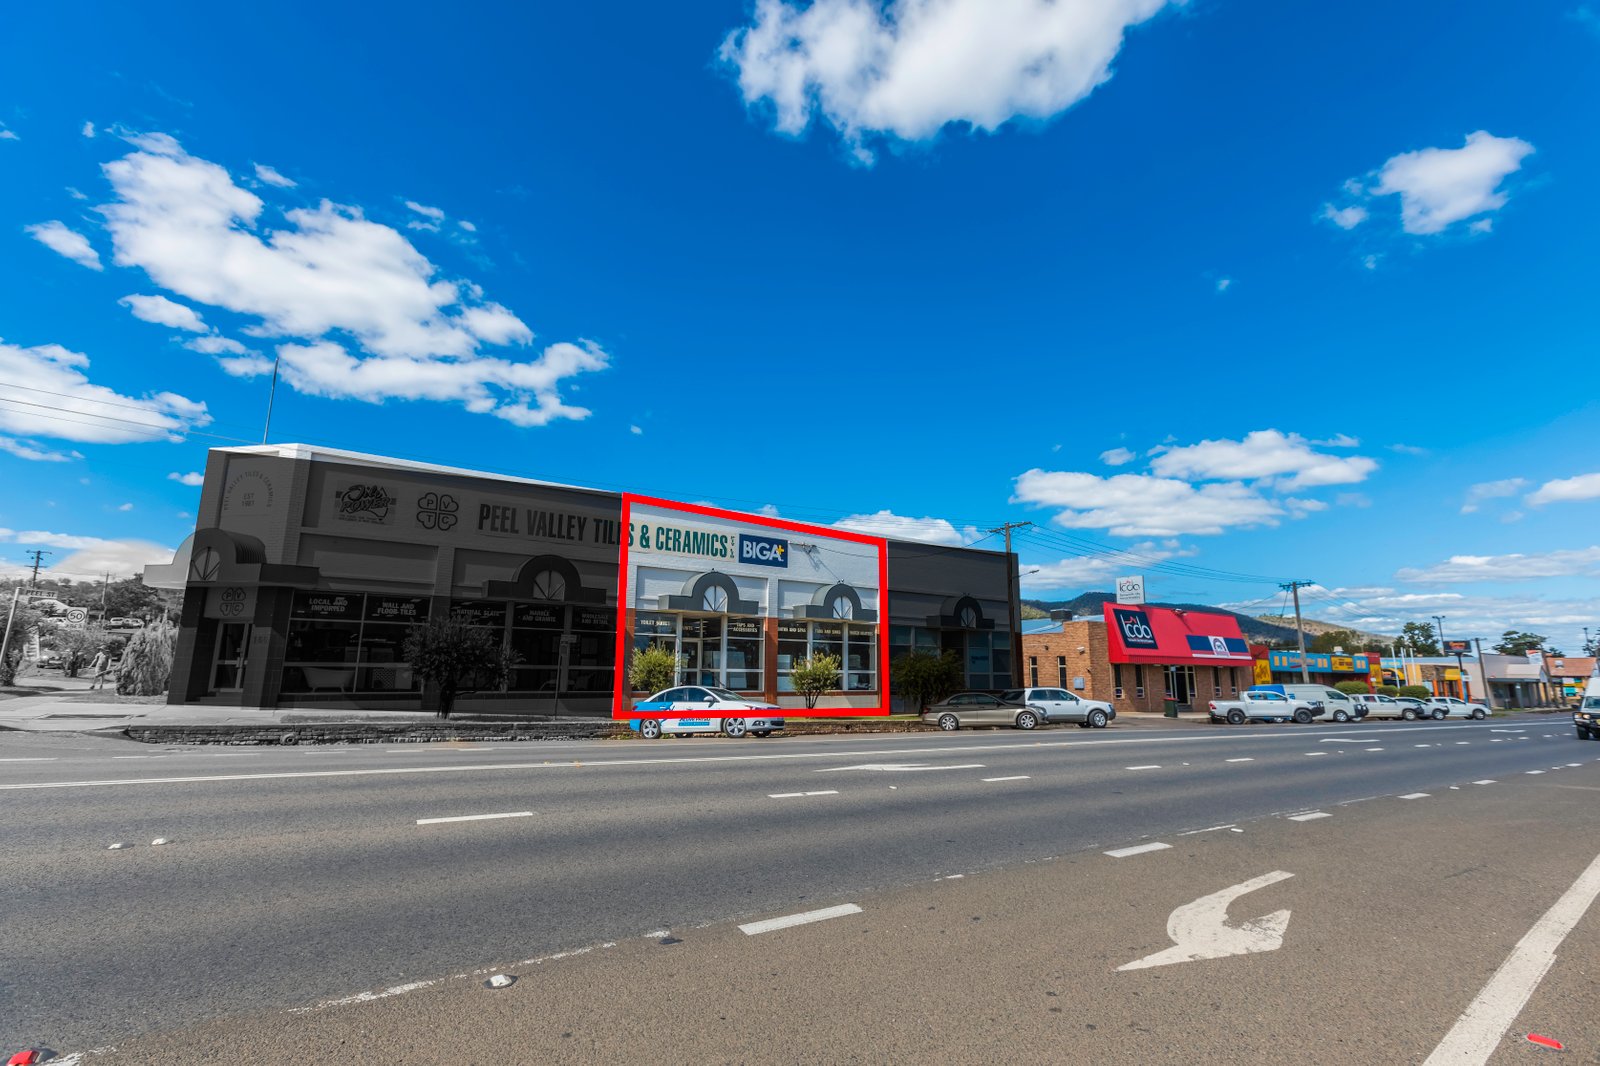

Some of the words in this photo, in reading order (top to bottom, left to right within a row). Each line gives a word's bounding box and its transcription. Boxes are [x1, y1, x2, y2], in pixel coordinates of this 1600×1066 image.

[427, 499, 434, 507] P
[443, 501, 451, 509] V
[426, 514, 434, 523] T
[442, 516, 450, 524] C
[478, 503, 519, 534] PEEL
[526, 509, 588, 542] VALLEY
[640, 524, 651, 550] &
[655, 526, 729, 559] CERAMICS
